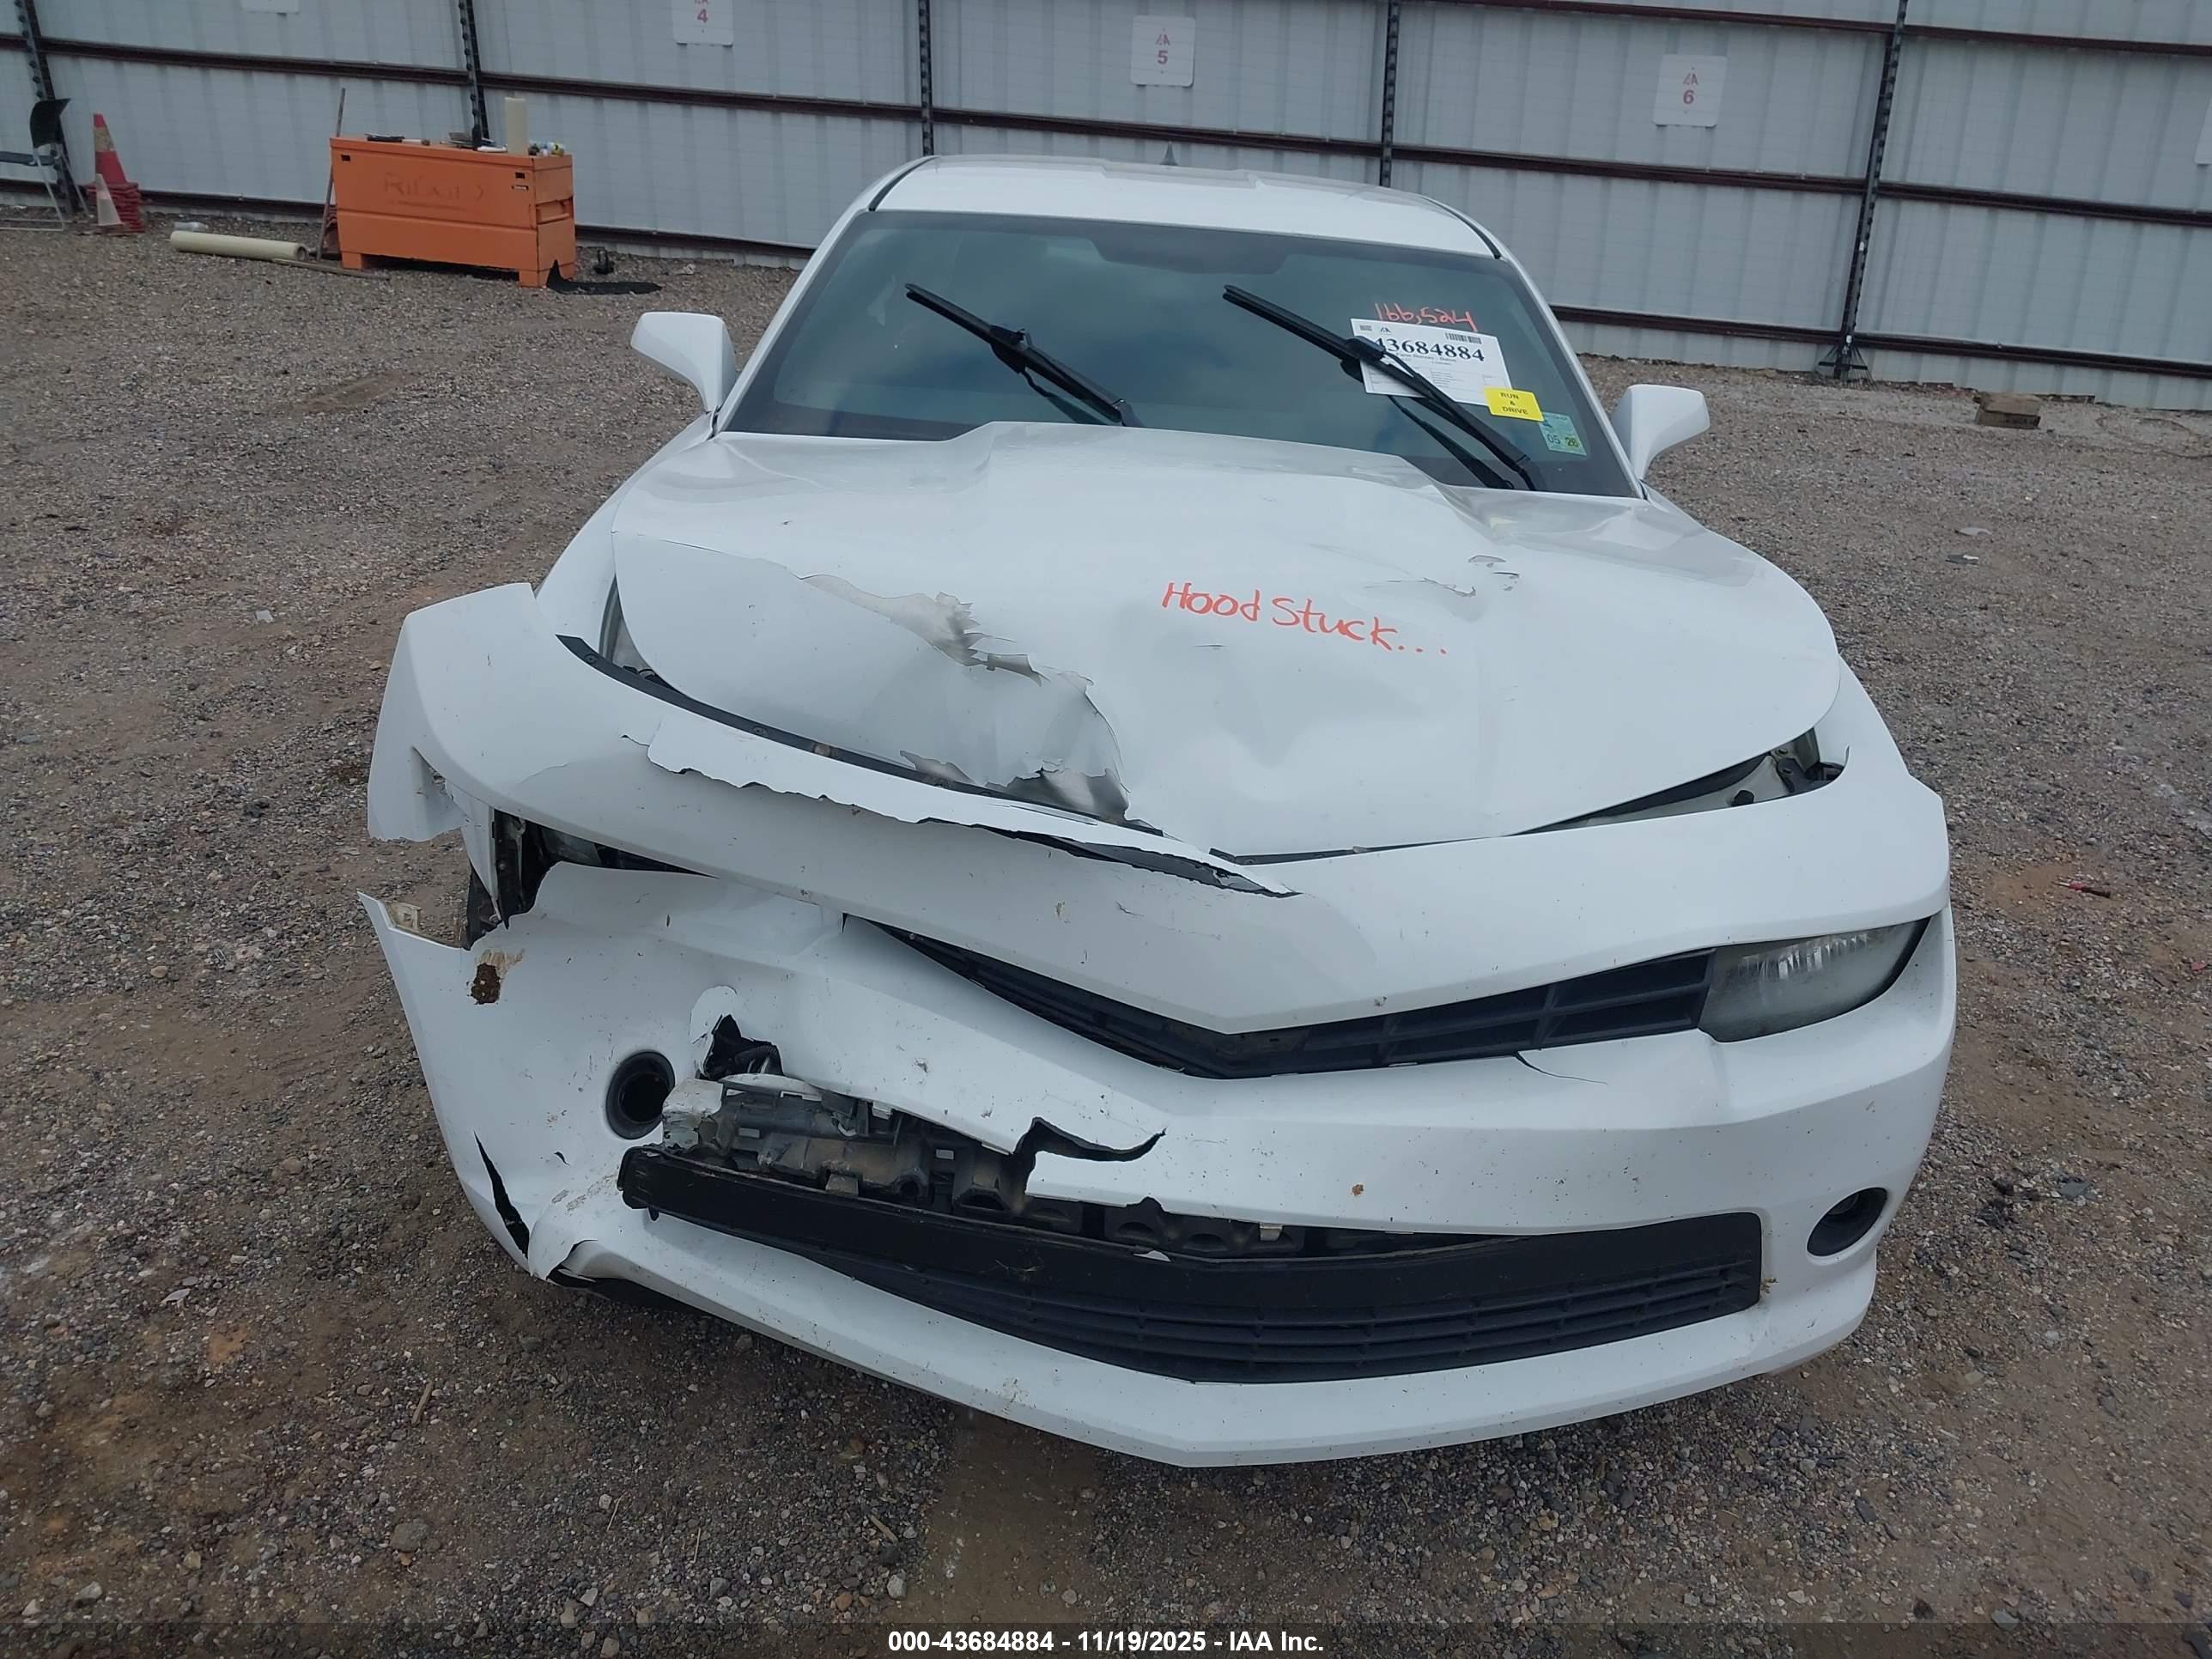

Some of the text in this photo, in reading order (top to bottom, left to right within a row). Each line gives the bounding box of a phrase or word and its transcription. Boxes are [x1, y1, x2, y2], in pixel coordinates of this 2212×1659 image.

[697, 9, 708, 23] 4
[1158, 50, 1169, 64] 5
[1683, 89, 1694, 105] 6
[1502, 406, 1528, 415] DRIVE
[1547, 433, 1561, 445] 05
[1161, 582, 1261, 621] Hood
